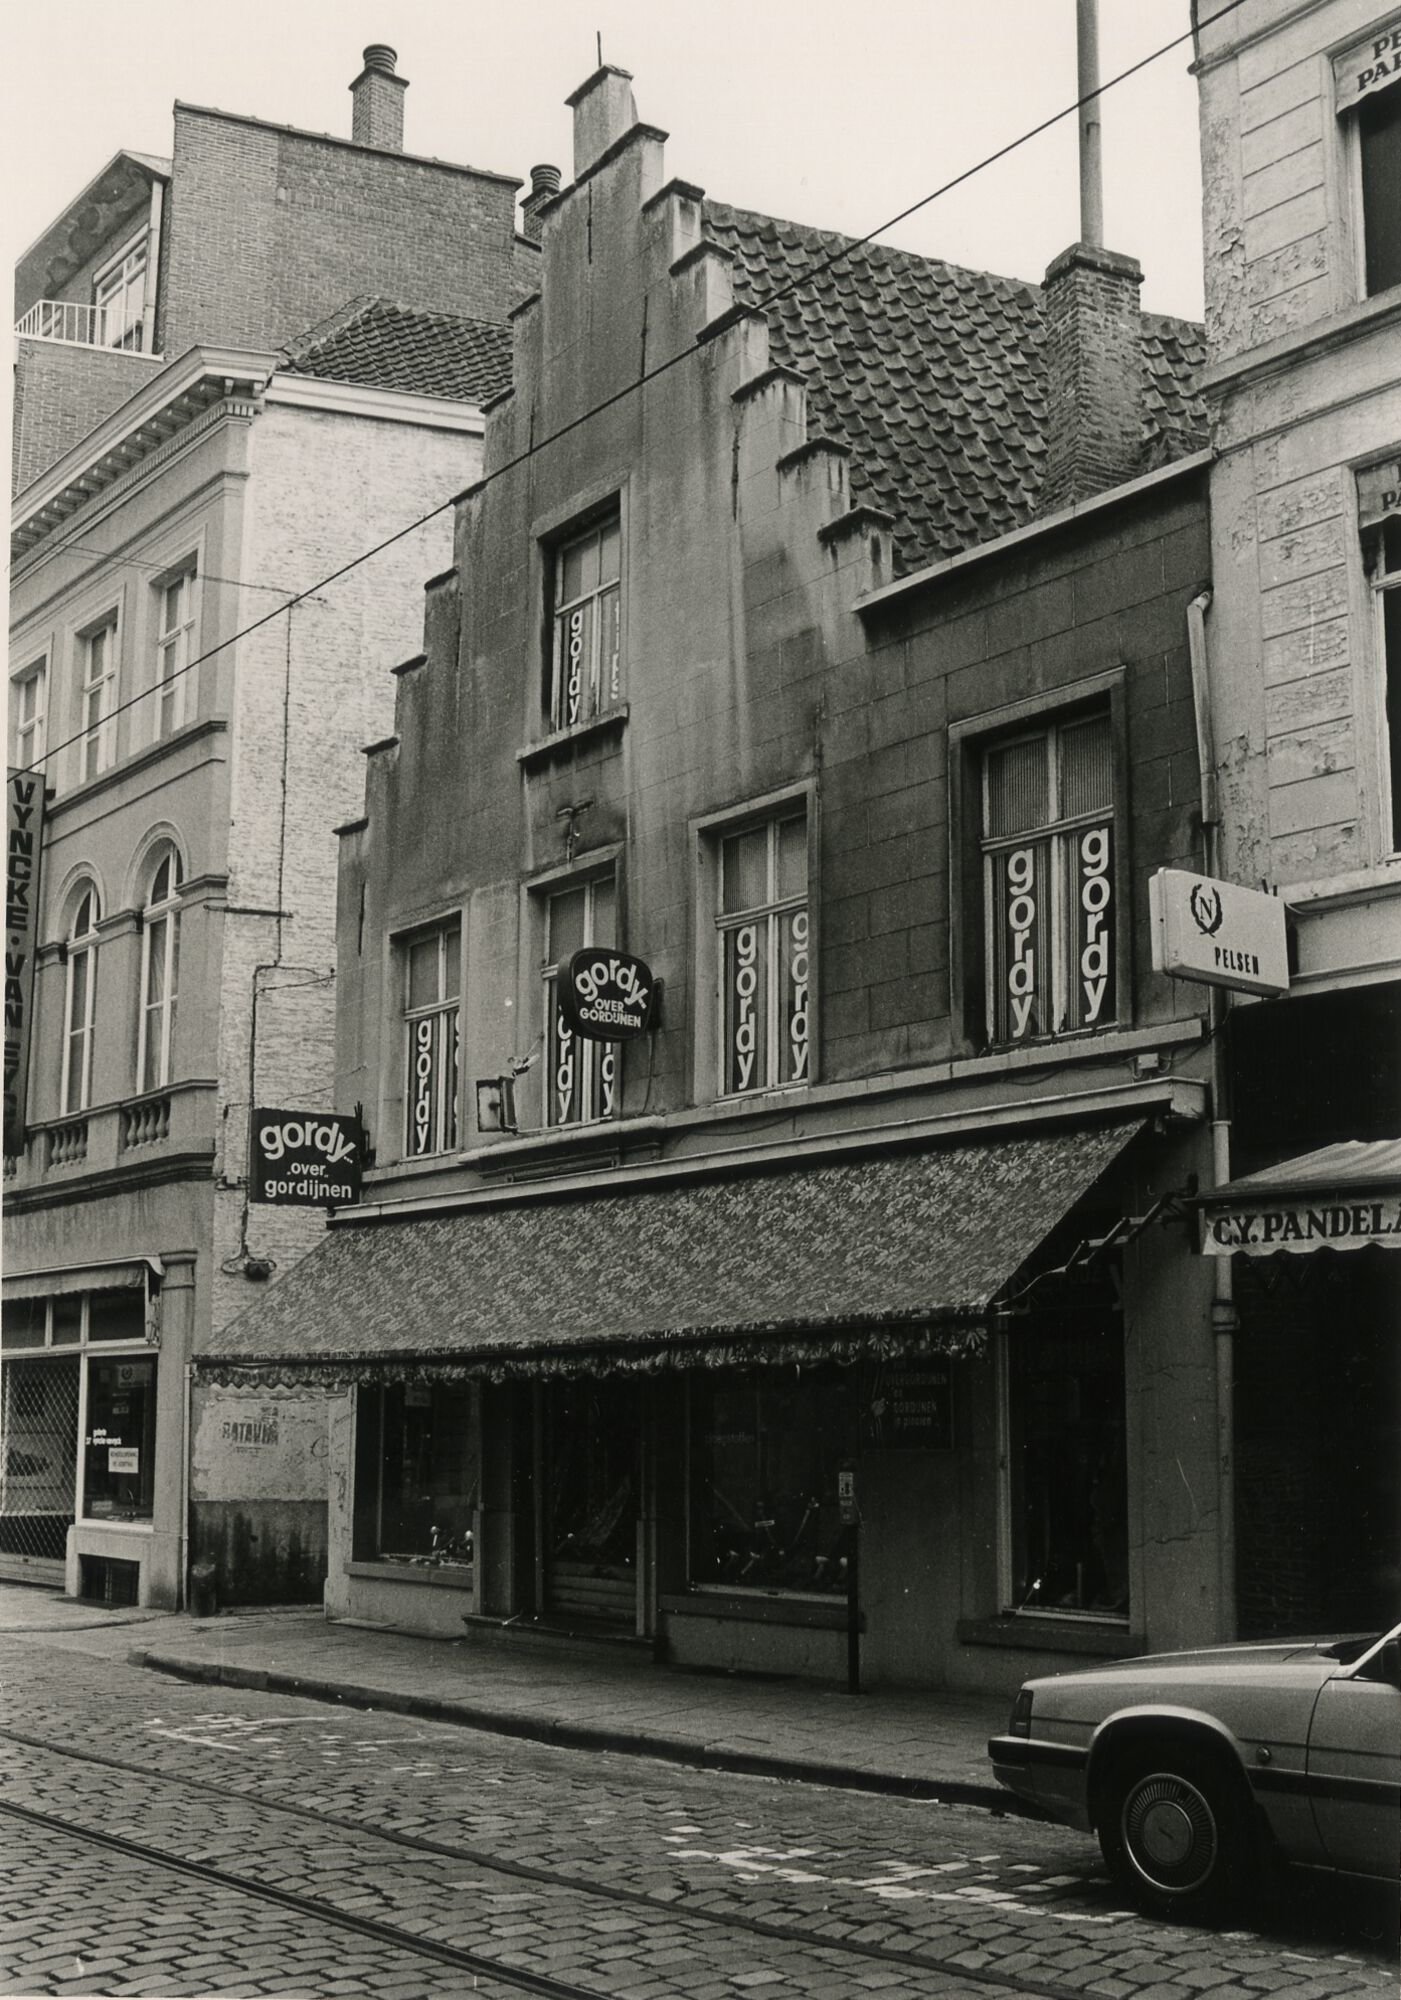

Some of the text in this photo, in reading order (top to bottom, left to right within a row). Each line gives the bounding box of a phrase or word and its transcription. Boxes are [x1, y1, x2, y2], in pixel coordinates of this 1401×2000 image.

[569, 609, 583, 724] gordy
[7, 779, 36, 931] VYNCKE
[1199, 896, 1213, 921] N
[1008, 848, 1035, 1038] gordy
[1081, 828, 1110, 1023] gordy
[1214, 946, 1259, 976] PELSEN
[5, 952, 25, 1029] VAN
[580, 1007, 642, 1028] GORDIJNEN
[736, 925, 757, 1090] gordy
[416, 1019, 432, 1154] gordy
[557, 1005, 573, 1124] ordy
[264, 1179, 352, 1200] gordijnen
